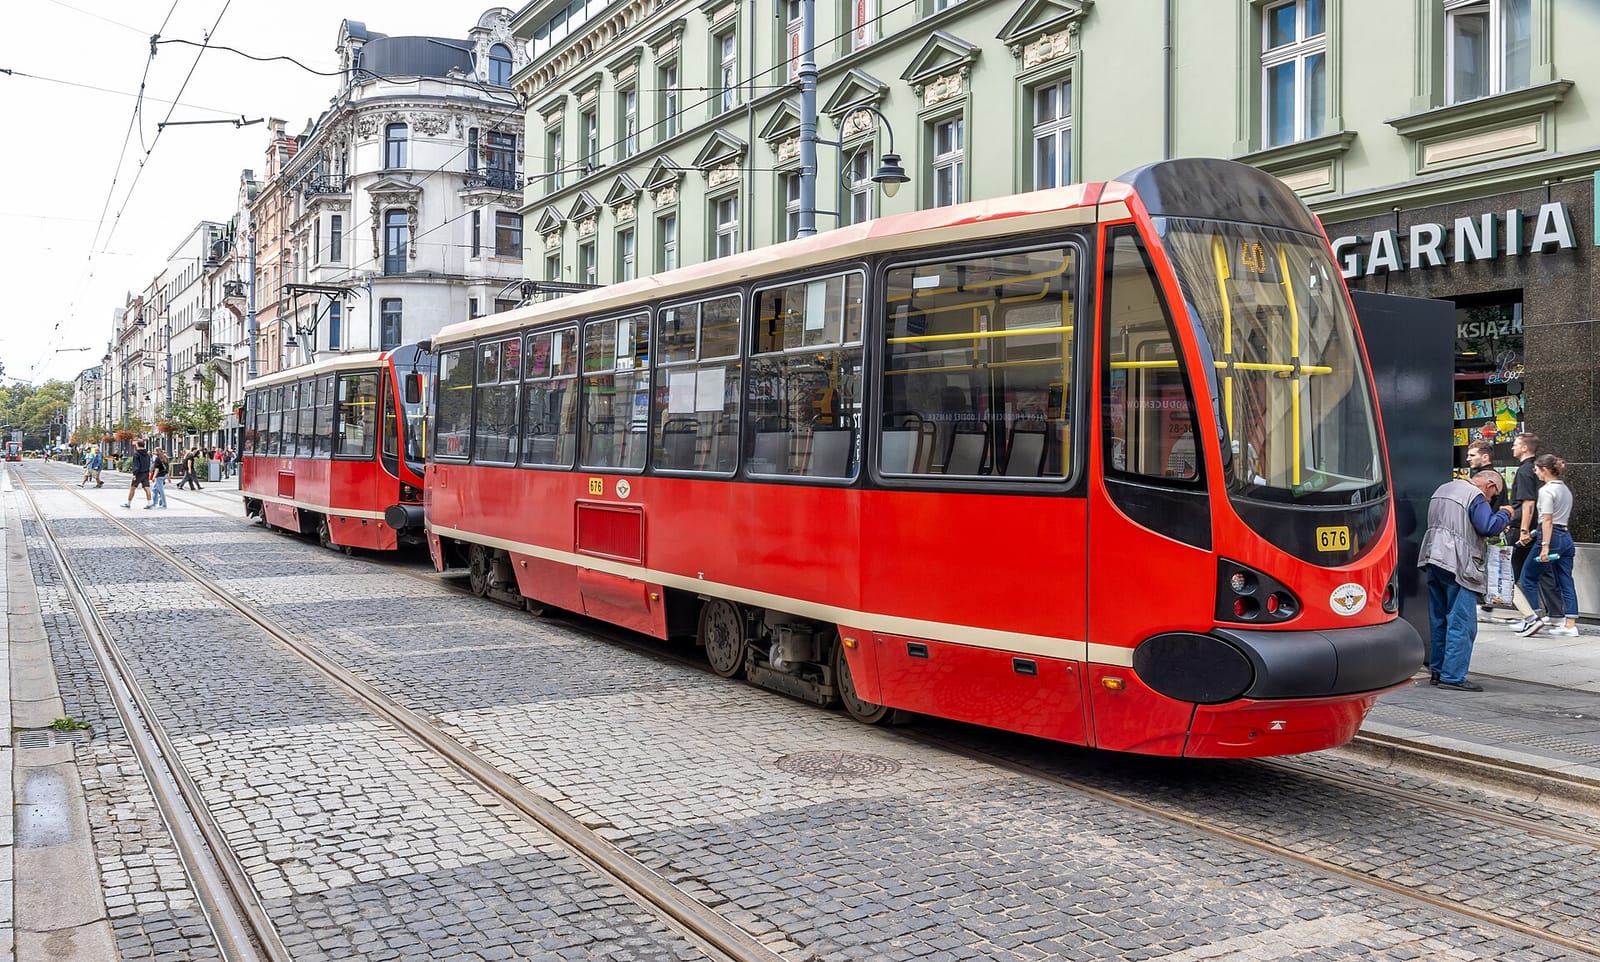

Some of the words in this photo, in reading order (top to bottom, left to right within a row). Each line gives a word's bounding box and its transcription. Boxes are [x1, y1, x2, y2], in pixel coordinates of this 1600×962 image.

[1332, 201, 1577, 280] GARNIA
[1241, 242, 1265, 274] 40
[590, 480, 602, 492] 676
[1321, 531, 1346, 547] 676
